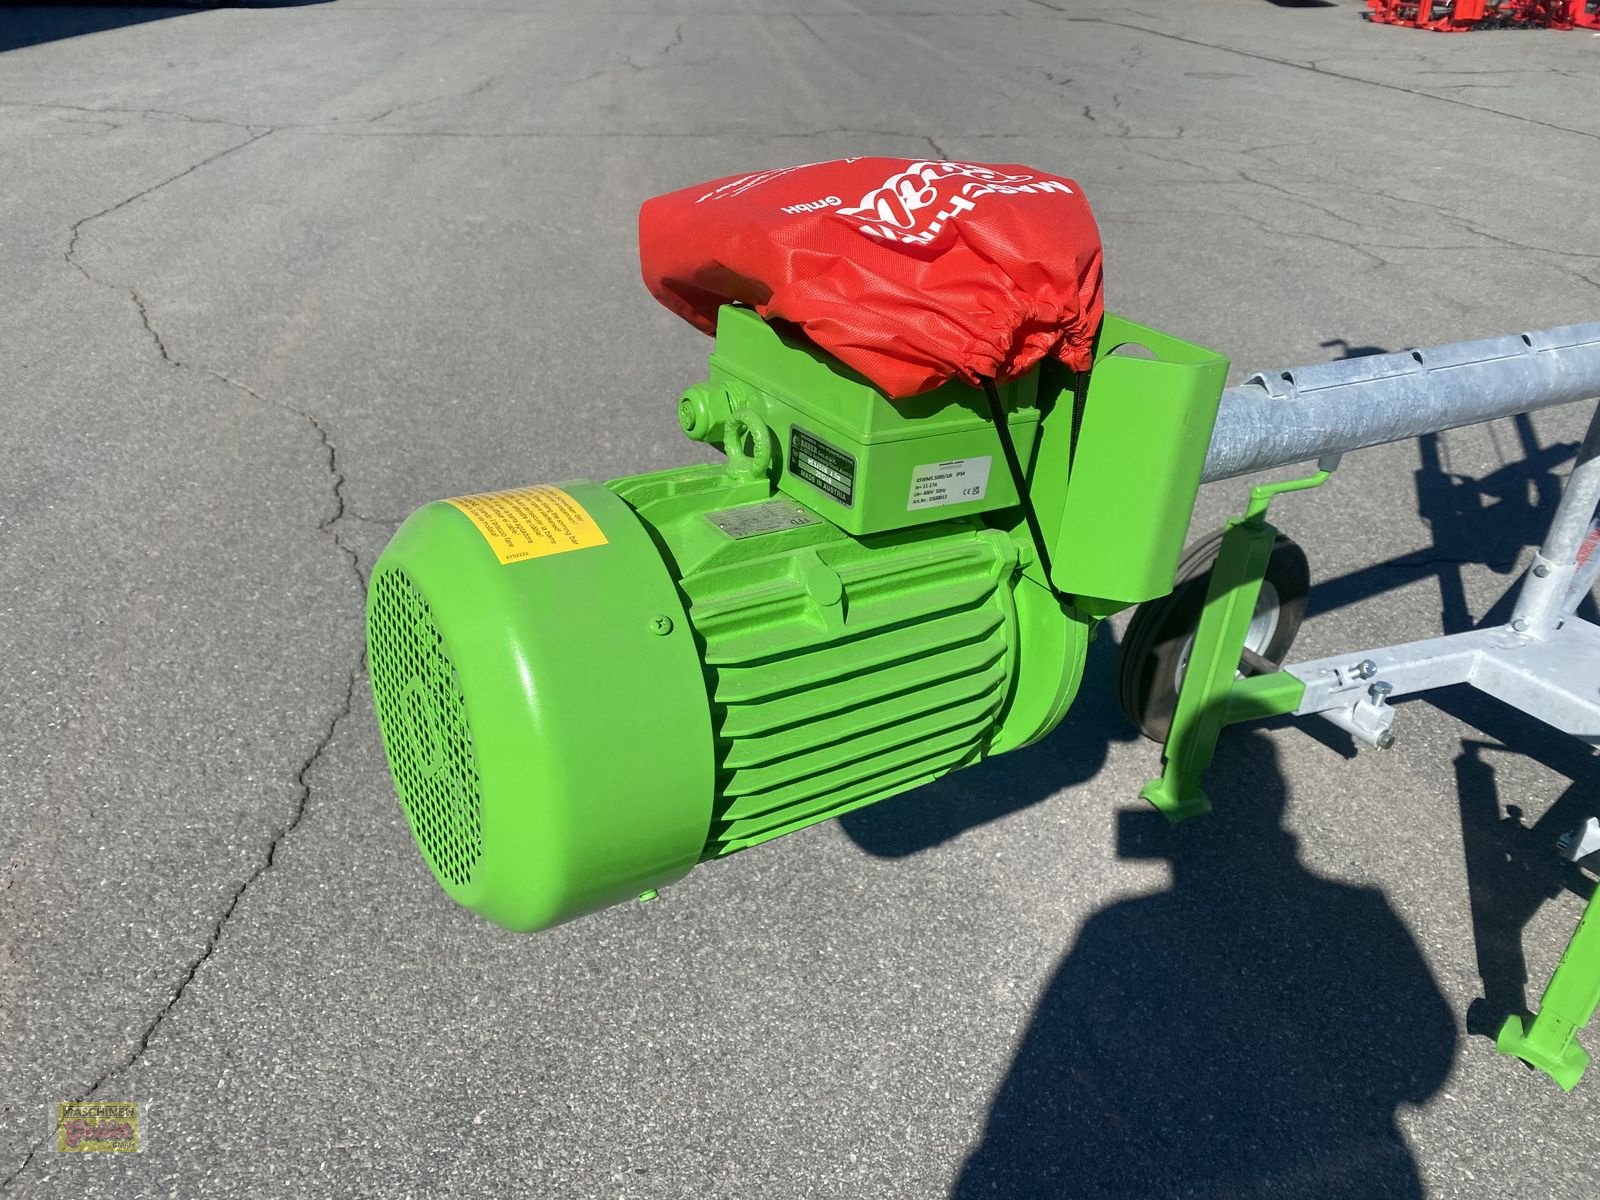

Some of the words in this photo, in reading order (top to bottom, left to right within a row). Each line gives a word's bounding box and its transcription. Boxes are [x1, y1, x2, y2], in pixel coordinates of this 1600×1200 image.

[780, 195, 842, 215] GmbH
[800, 469, 816, 484] MADE
[816, 479, 823, 488] IN
[823, 483, 847, 501] AUSTRIA
